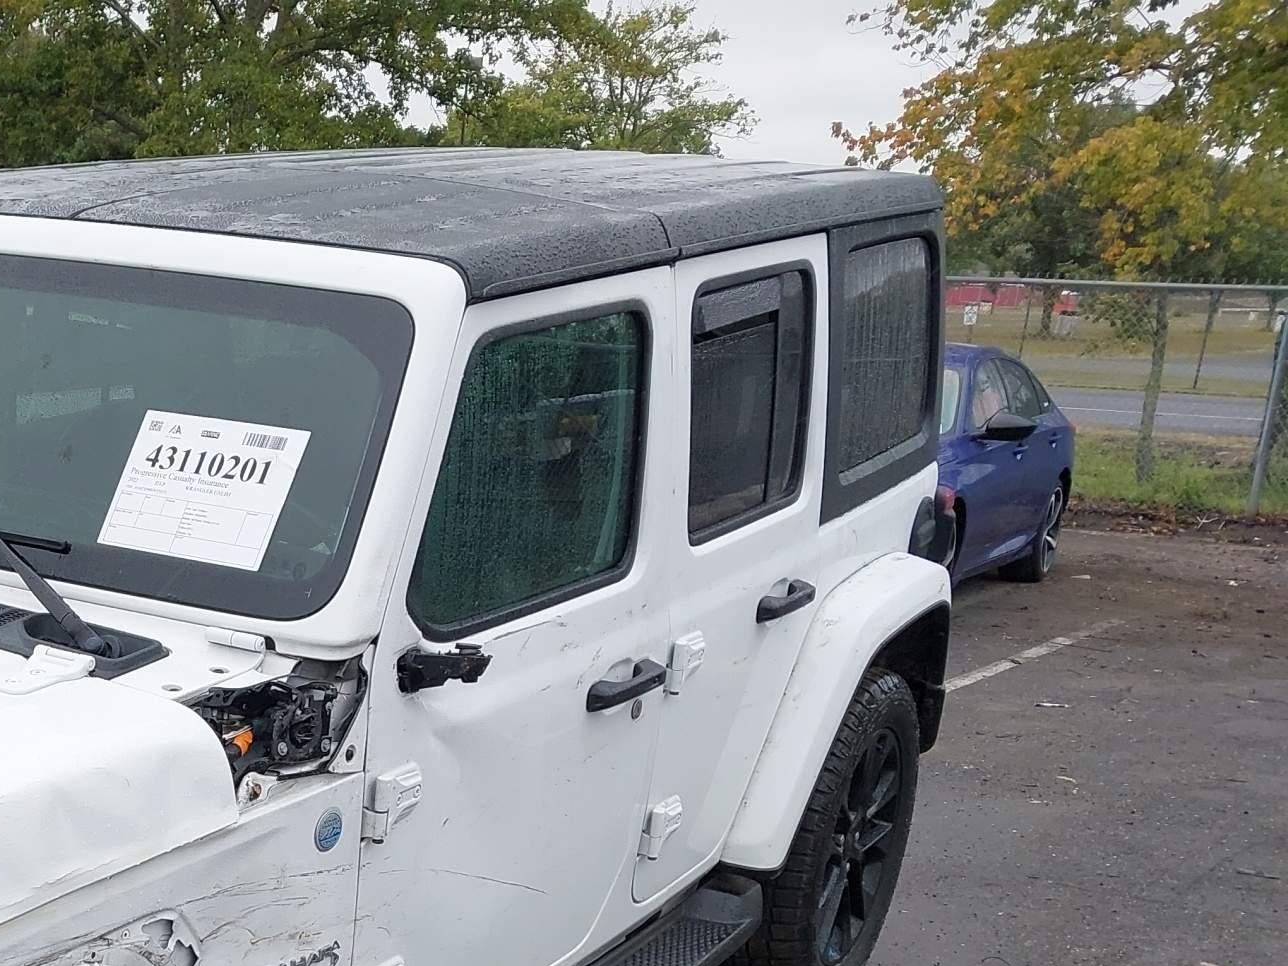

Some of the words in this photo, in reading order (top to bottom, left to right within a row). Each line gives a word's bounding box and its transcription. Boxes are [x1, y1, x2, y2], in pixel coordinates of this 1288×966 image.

[131, 467, 168, 481] Progressive
[168, 472, 196, 486] Casualty
[197, 475, 230, 489] Insurance
[145, 444, 273, 485] 43110201
